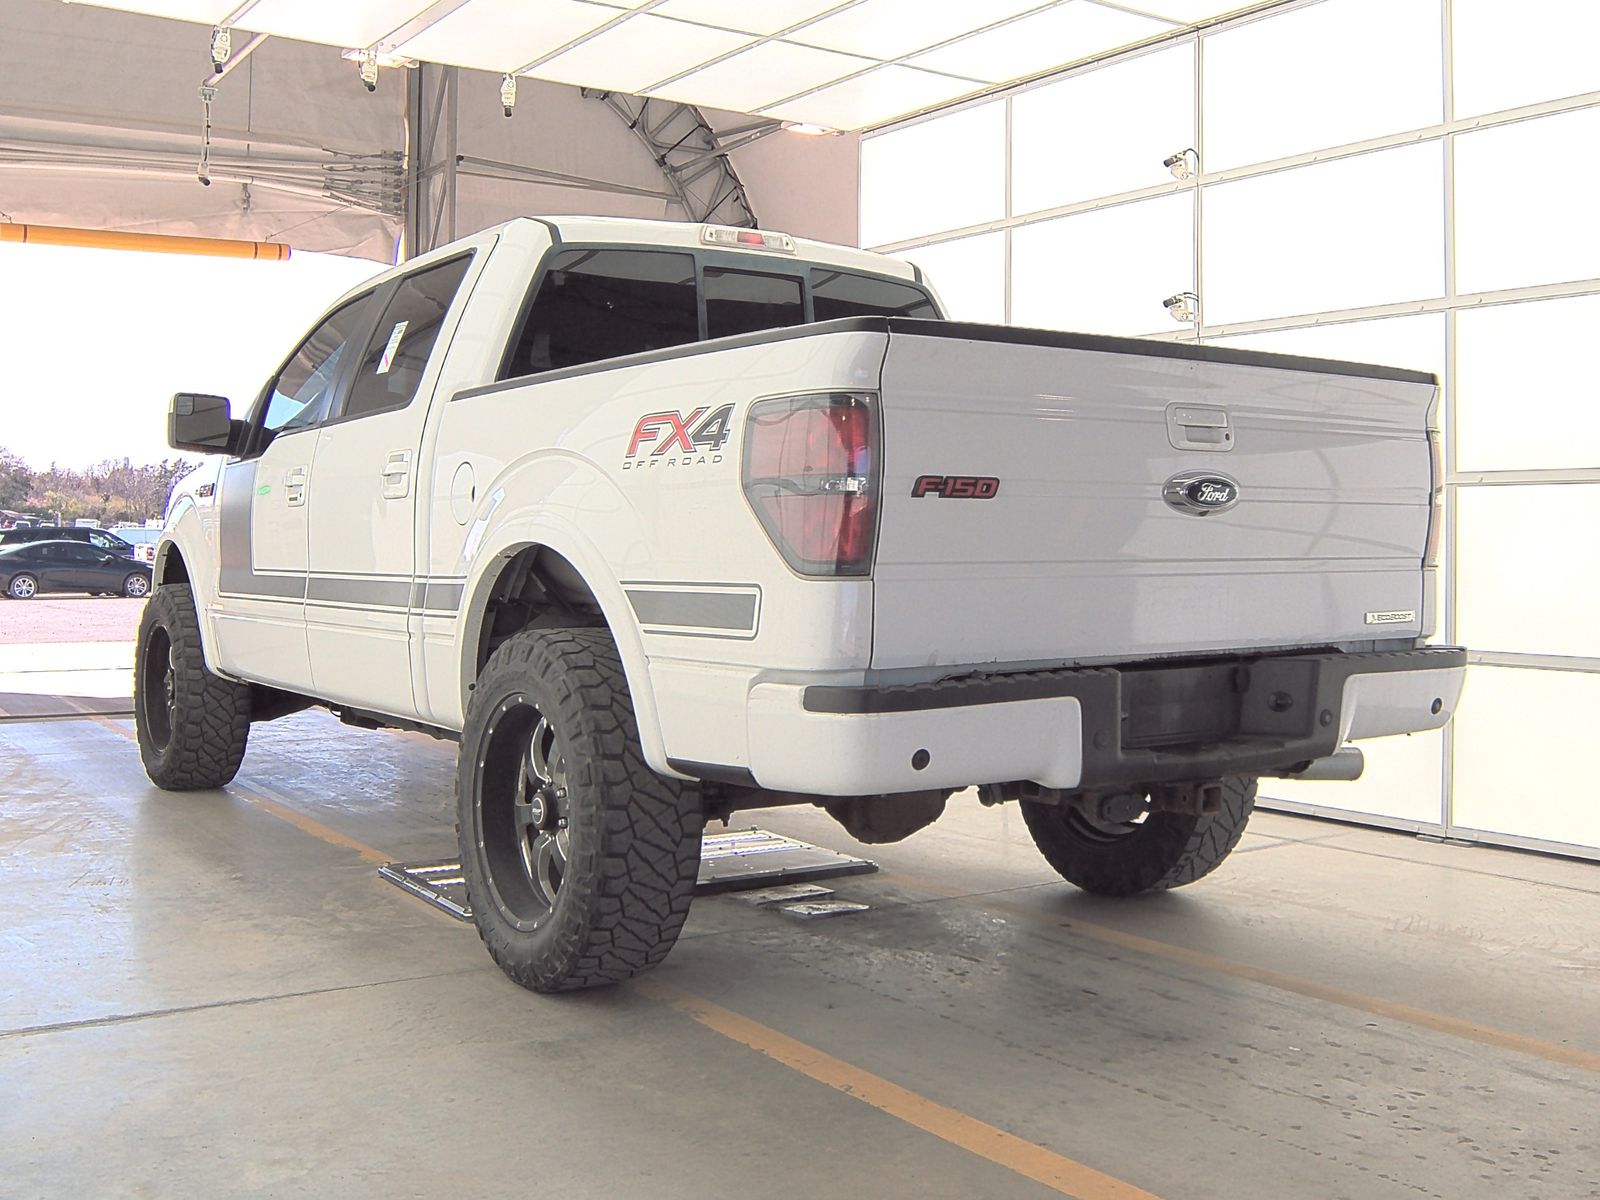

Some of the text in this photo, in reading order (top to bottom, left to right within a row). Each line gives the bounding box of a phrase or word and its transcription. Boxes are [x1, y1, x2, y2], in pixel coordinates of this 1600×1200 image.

[625, 402, 735, 458] FX4
[622, 455, 723, 470] OFF ROAD
[911, 475, 1000, 499] F-150
[1197, 482, 1230, 502] Ford
